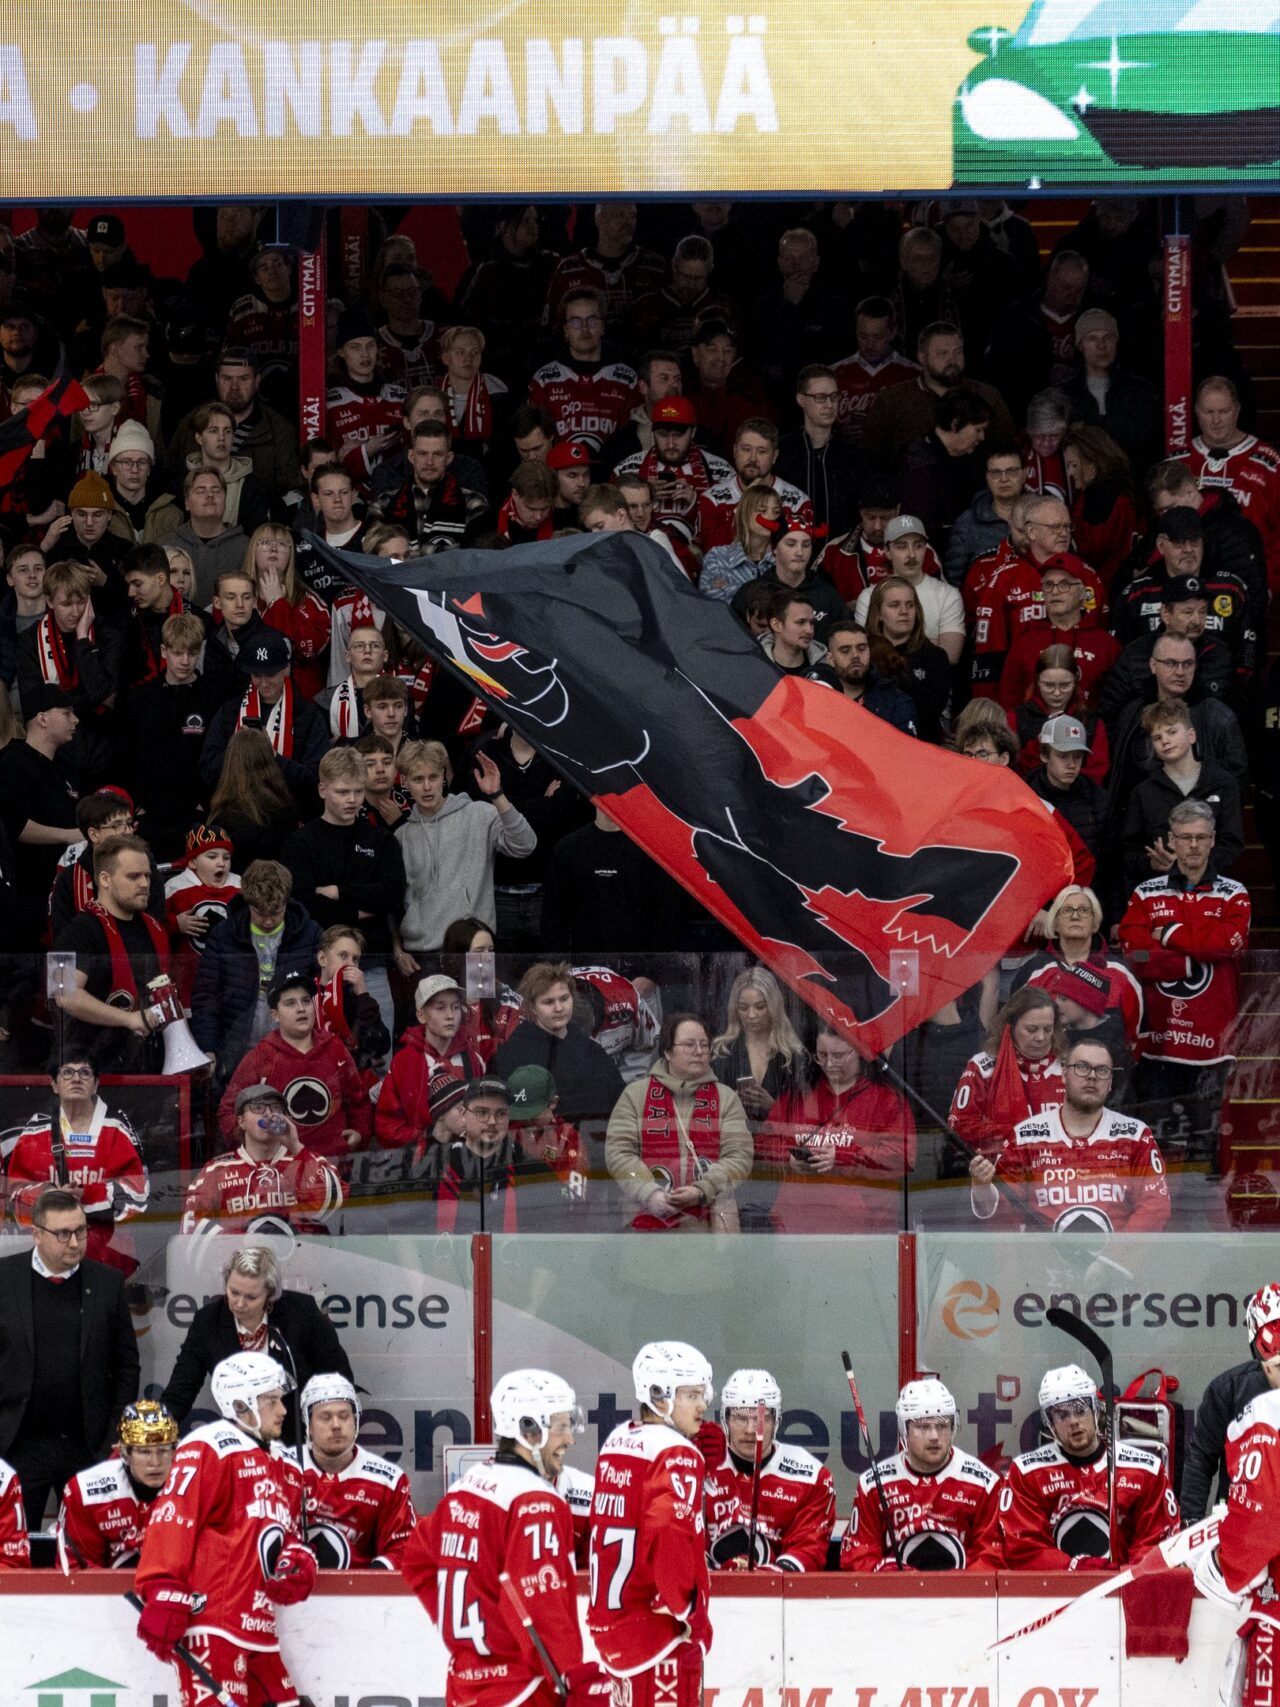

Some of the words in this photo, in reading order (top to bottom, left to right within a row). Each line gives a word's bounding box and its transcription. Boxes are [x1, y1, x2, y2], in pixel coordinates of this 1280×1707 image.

[135, 15, 778, 141] KANKAANPÄÄ
[1035, 1184, 1128, 1207] BOLIDEN
[1120, 1447, 1156, 1460] WESTAS
[782, 1455, 814, 1471] WESTAS
[1233, 1450, 1262, 1484] 30
[238, 1465, 267, 1479] EUPART
[85, 1475, 117, 1488] WESTAS
[164, 1465, 198, 1497] 37
[1042, 1480, 1075, 1496] EUPART
[670, 1474, 698, 1505] 67
[761, 1490, 798, 1503] OLMAR
[344, 1493, 379, 1506] OLMAR
[941, 1491, 977, 1506] OLMAR
[1164, 1488, 1178, 1517] 8
[99, 1515, 133, 1531] EUPART
[524, 1522, 559, 1560] 74
[589, 1526, 637, 1611] 67
